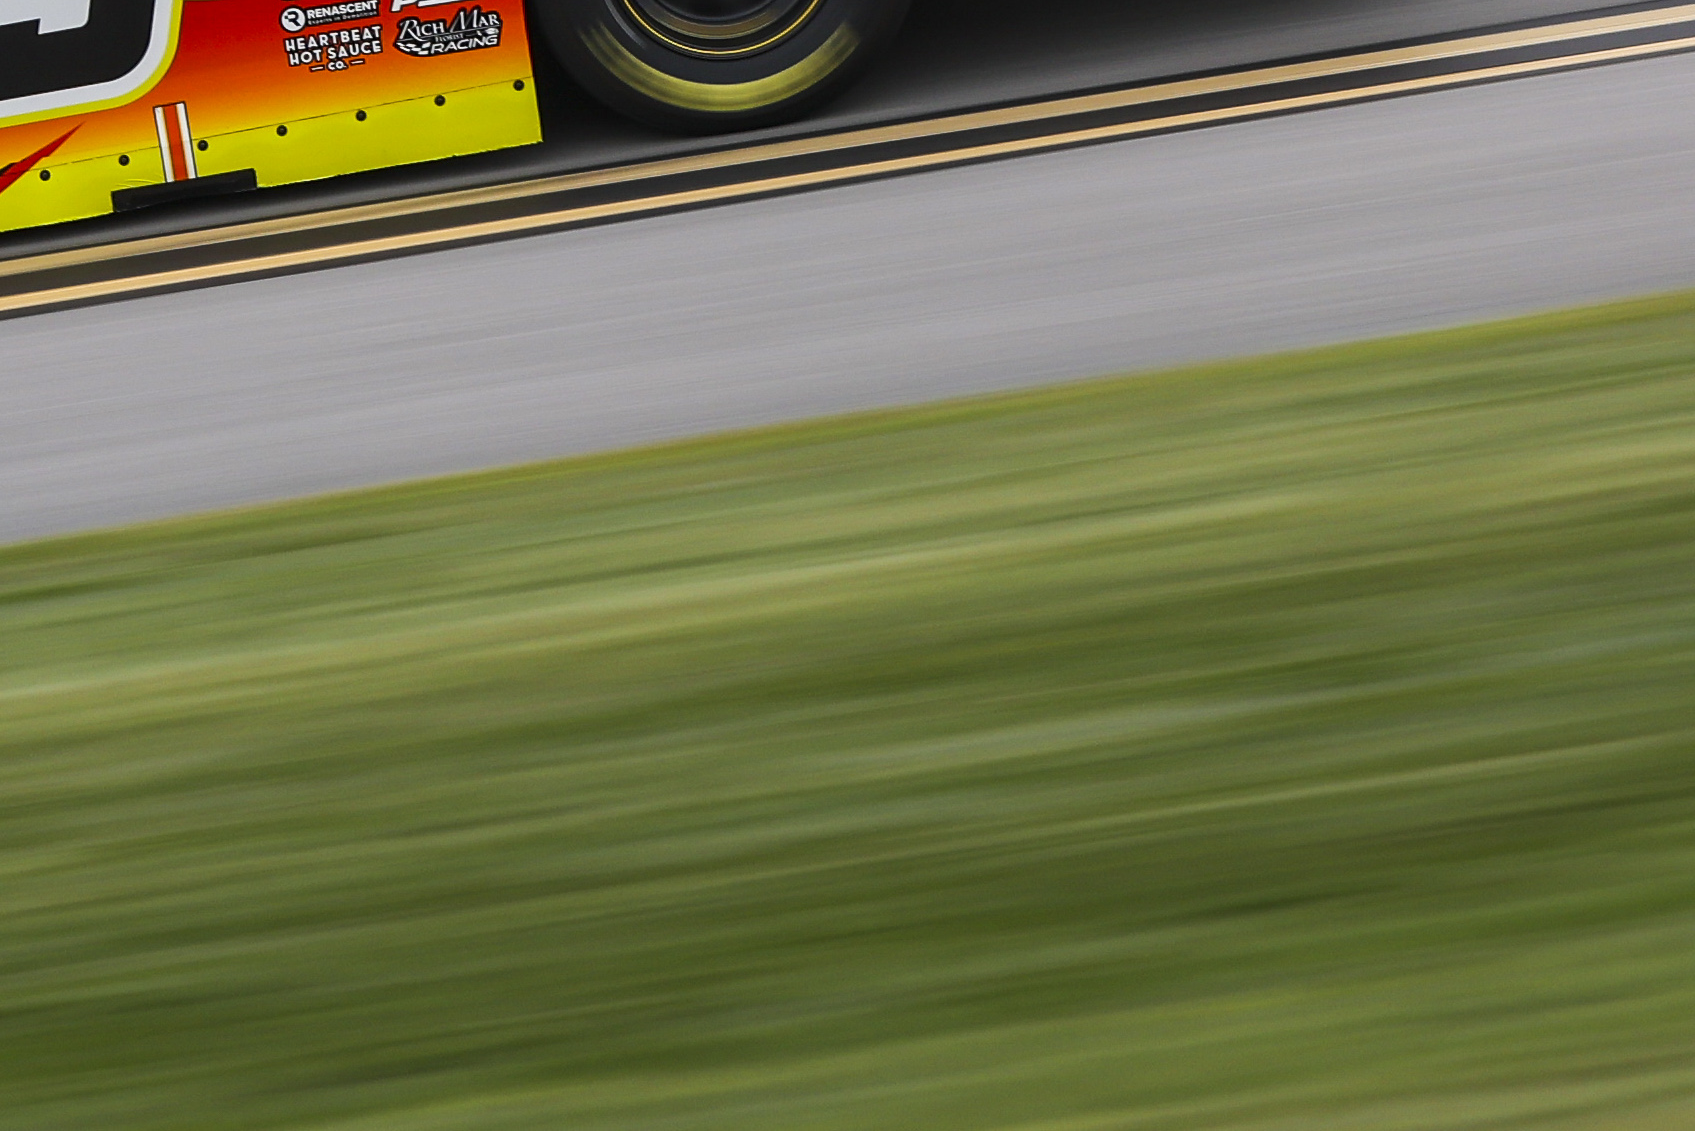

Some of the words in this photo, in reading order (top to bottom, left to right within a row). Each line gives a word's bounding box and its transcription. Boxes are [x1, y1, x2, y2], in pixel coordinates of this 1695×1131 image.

[306, 0, 379, 19] RENASCENT
[285, 25, 382, 52] HEARTBEAT
[430, 34, 498, 55] RACING
[289, 49, 322, 66] HOT
[327, 40, 382, 60] SAUCE
